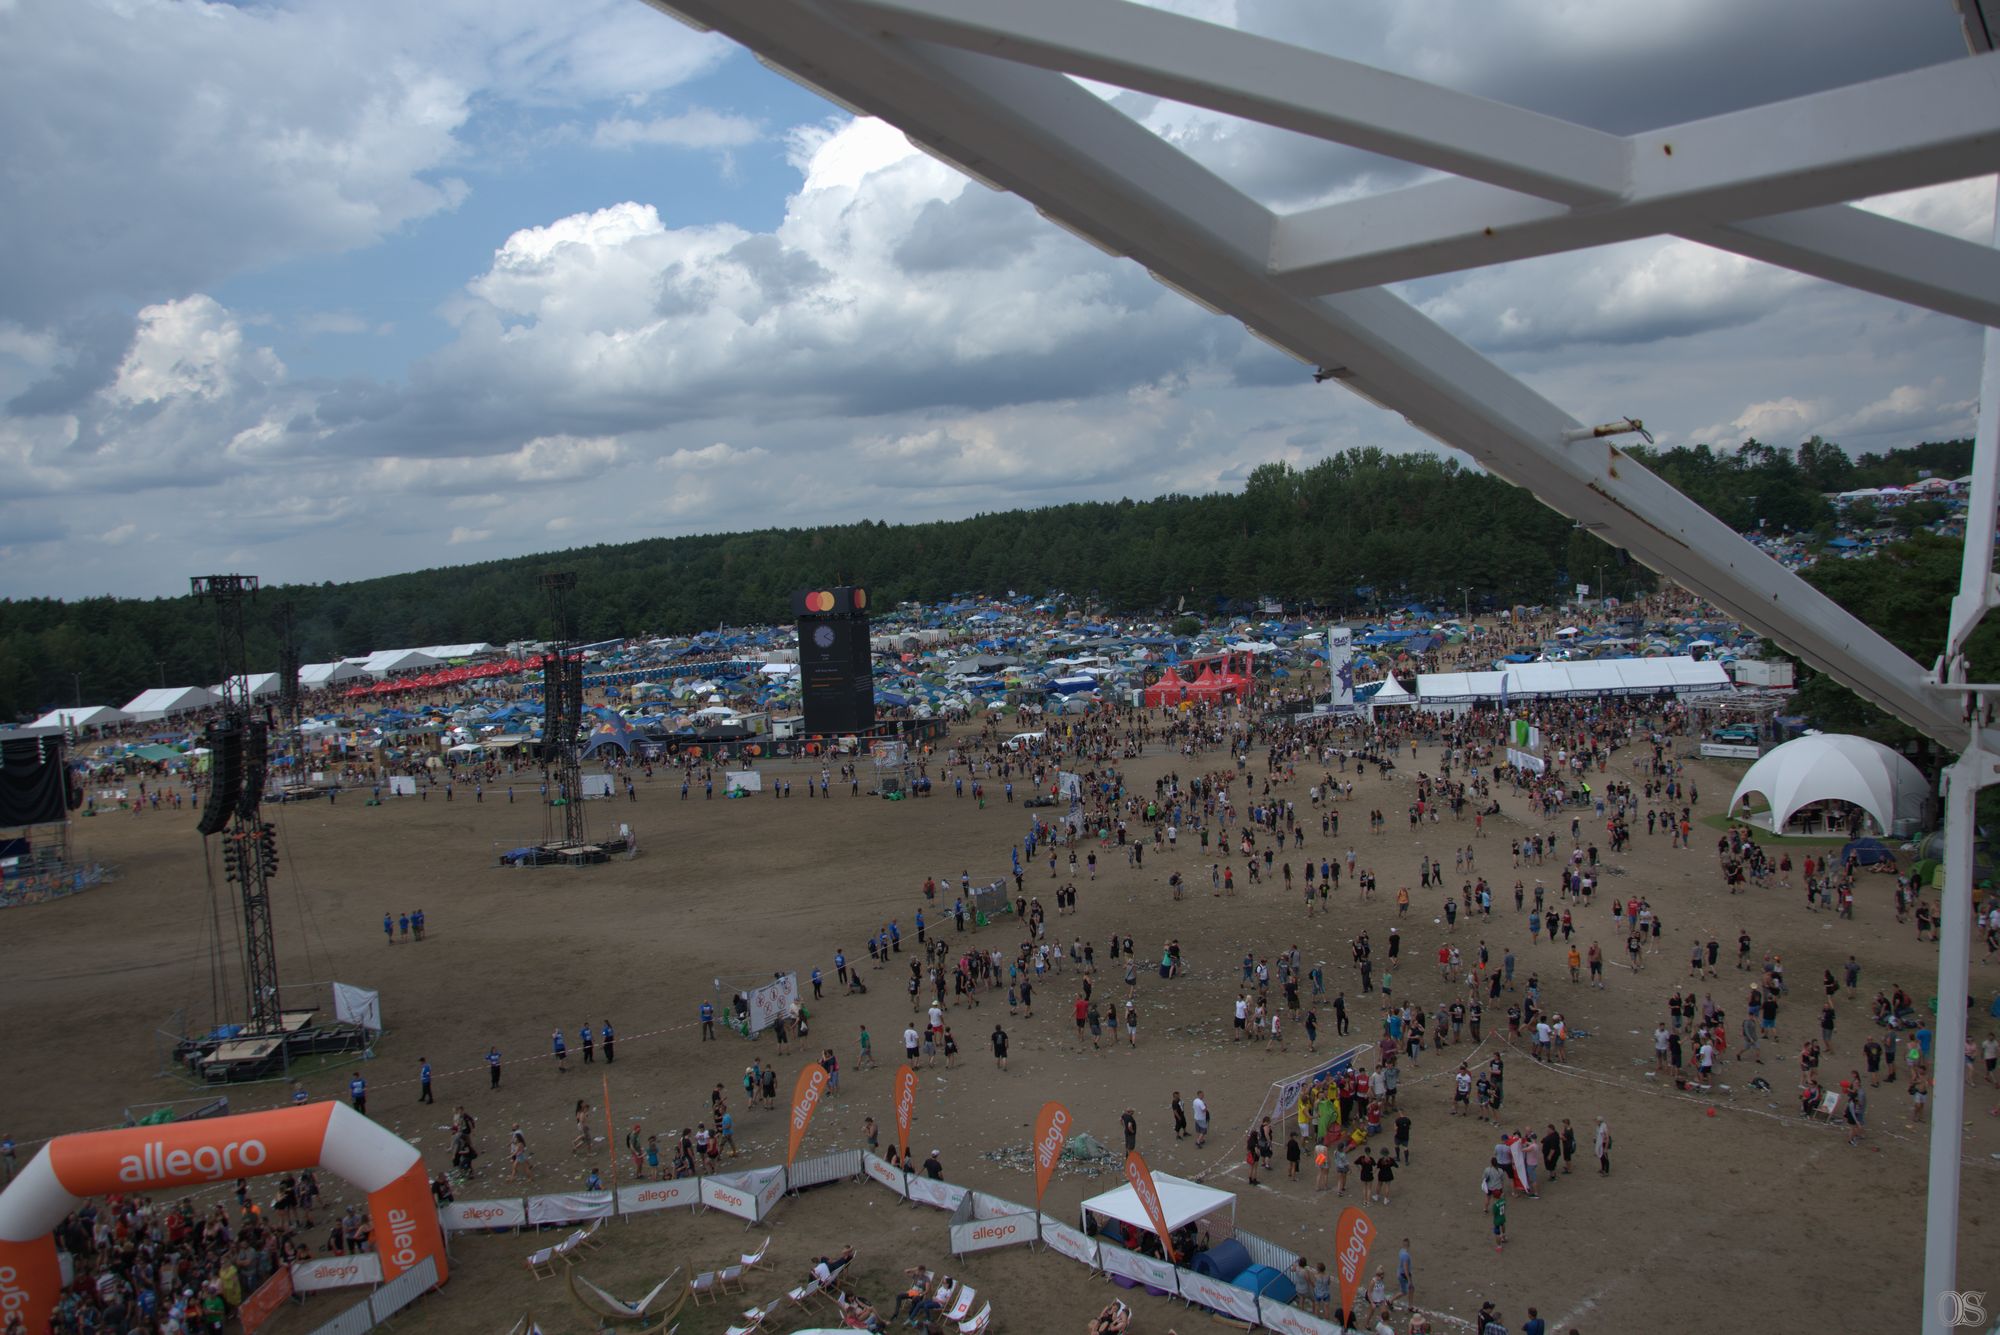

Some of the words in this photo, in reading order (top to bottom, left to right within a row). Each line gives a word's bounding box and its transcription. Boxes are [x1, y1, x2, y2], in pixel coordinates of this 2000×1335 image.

[793, 1070, 823, 1130] allegro
[897, 1073, 914, 1129] allegro
[1037, 1110, 1066, 1168] allegro
[119, 1139, 267, 1182] allegro
[638, 1188, 679, 1202] allegro
[714, 1189, 742, 1207] allegro
[463, 1207, 504, 1221] allegro
[972, 1224, 1016, 1240] allegro
[1339, 1218, 1368, 1283] allegro
[314, 1264, 358, 1280] allegro
